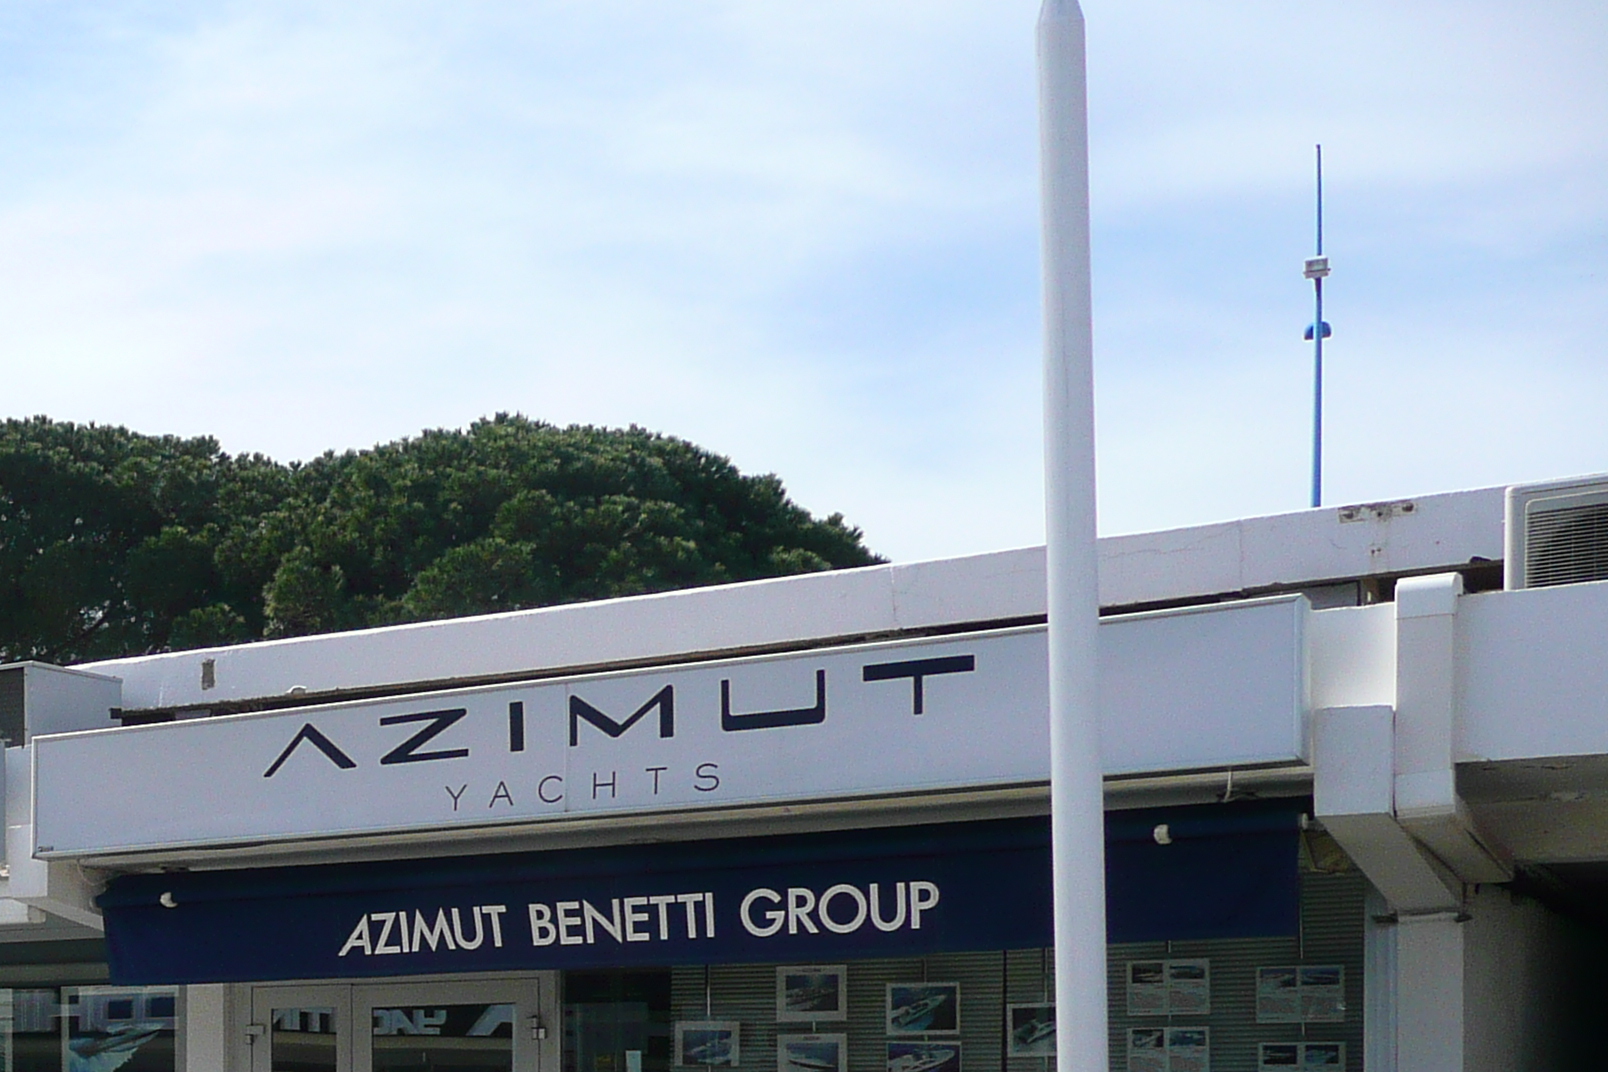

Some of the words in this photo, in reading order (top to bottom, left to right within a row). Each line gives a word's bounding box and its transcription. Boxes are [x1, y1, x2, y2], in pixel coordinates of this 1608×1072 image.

[263, 654, 976, 778] AZIMUT
[445, 763, 721, 812] YACHTS
[337, 903, 507, 958] AZIMUT
[529, 892, 716, 948] BENETTI
[739, 880, 940, 937] GROUP
